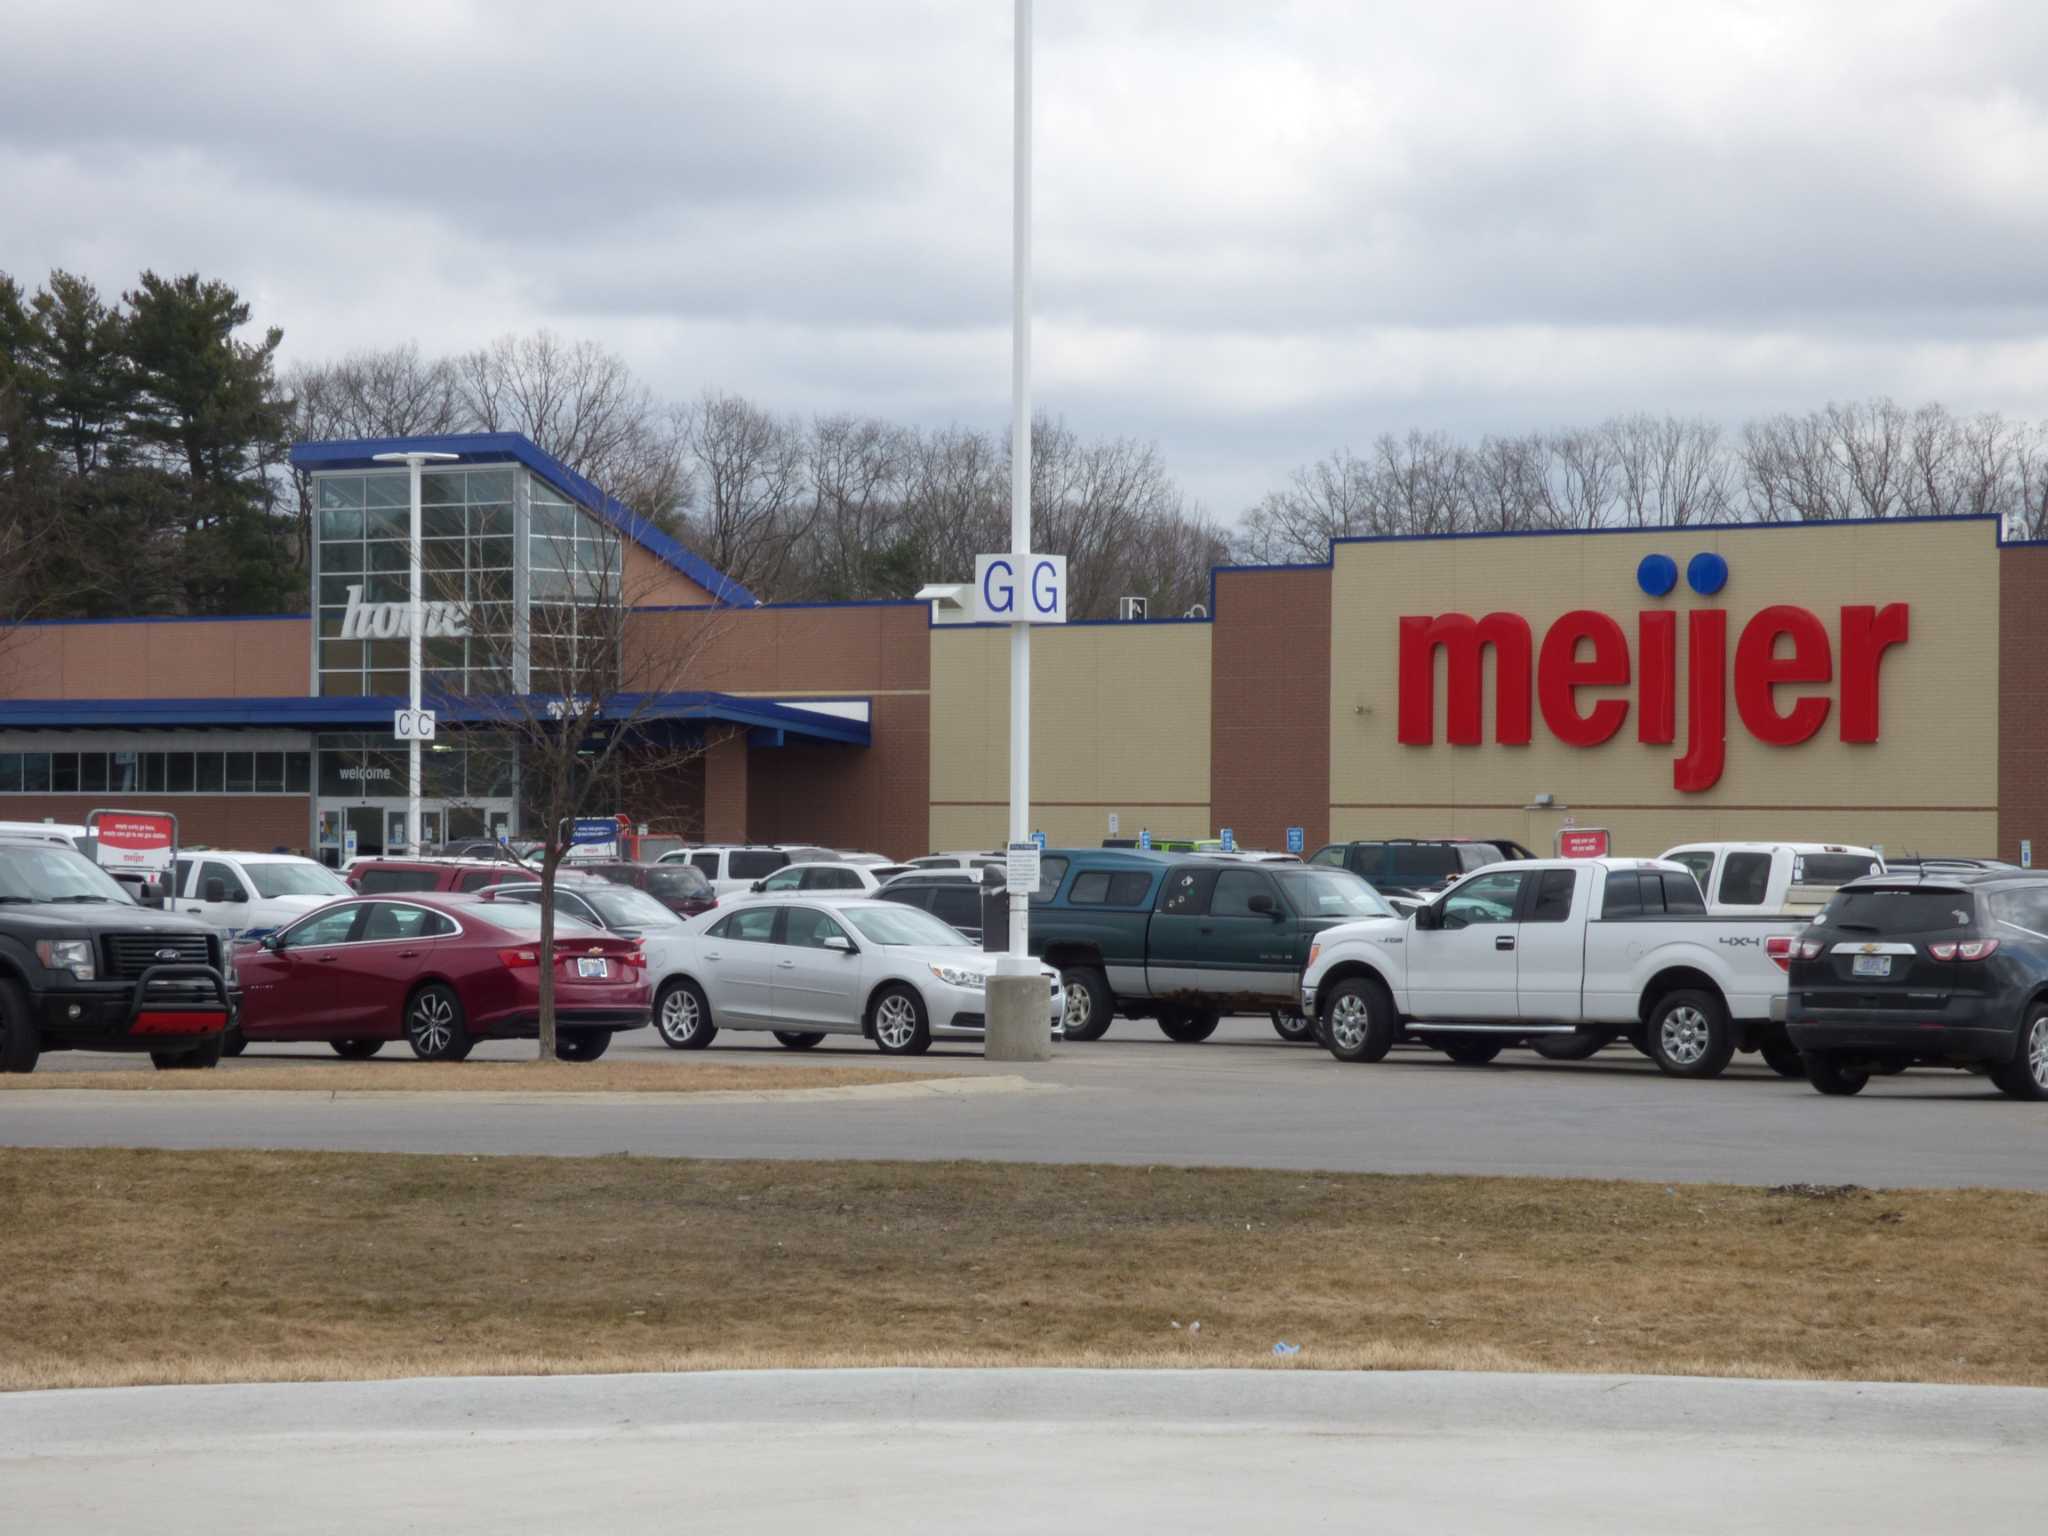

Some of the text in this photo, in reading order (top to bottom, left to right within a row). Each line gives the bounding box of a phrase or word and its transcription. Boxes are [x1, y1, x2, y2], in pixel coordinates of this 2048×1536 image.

[340, 584, 474, 639] home
[983, 560, 1013, 613] G
[1031, 561, 1057, 614] G
[1398, 552, 1909, 792] meijer
[399, 713, 410, 736] C
[417, 713, 431, 736] C
[339, 765, 391, 780] welcome
